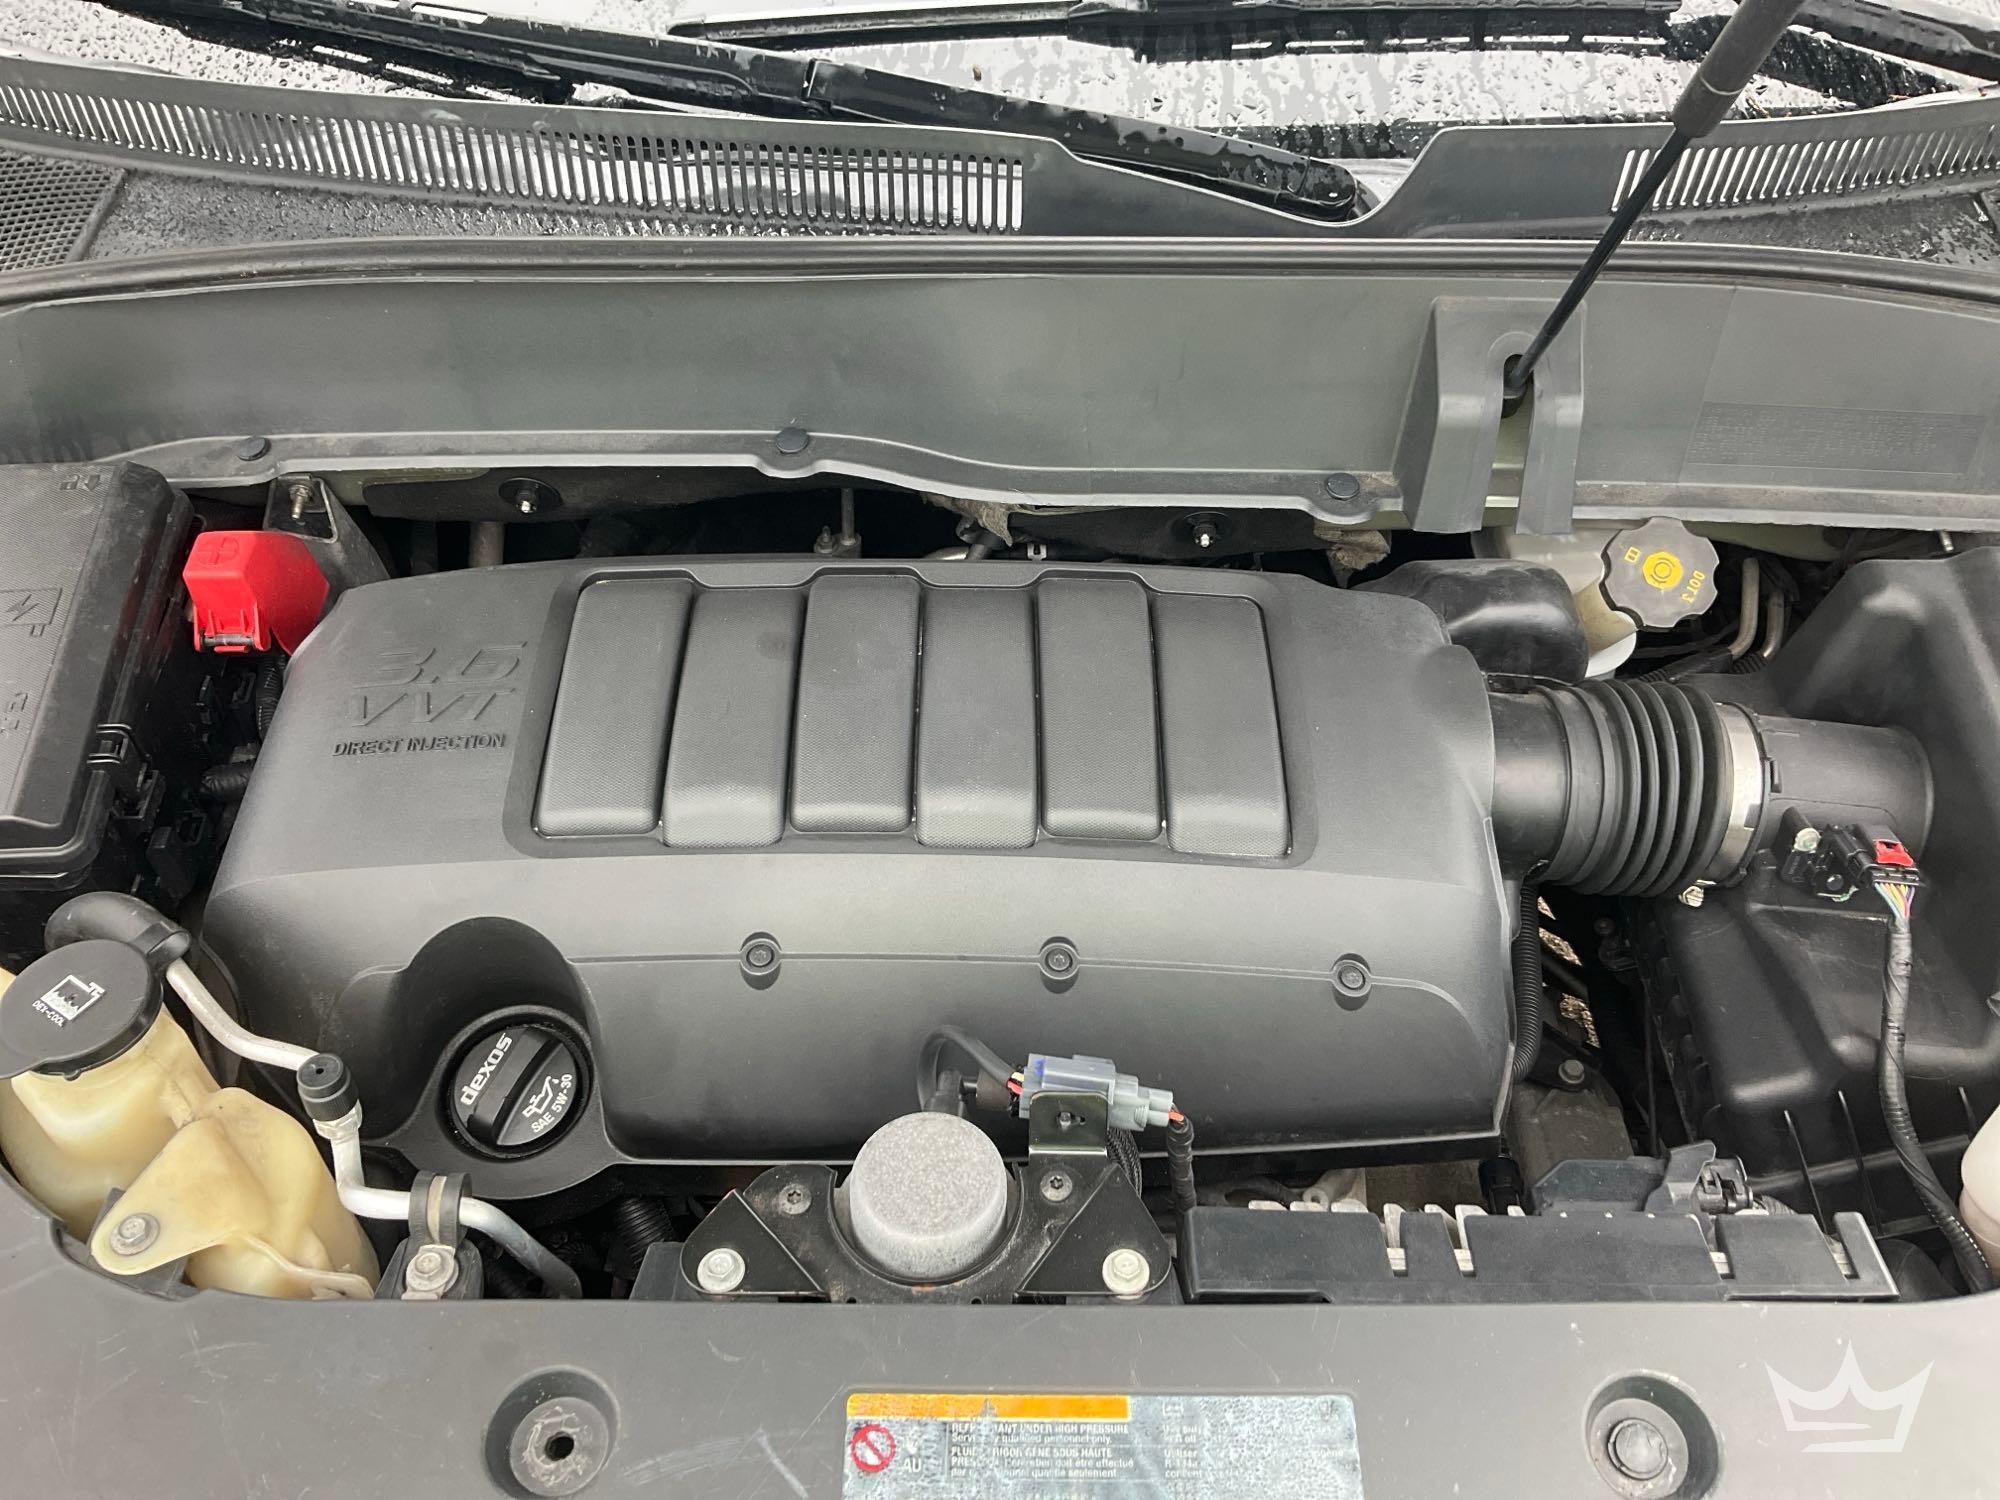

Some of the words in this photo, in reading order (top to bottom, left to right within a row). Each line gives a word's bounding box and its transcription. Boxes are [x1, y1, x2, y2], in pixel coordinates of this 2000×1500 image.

[1686, 570, 1706, 596] DOT
[350, 688, 516, 728] VVT
[332, 738, 405, 757] DIRECT
[406, 733, 508, 754] INJECTION
[32, 1000, 65, 1027] DEX-COOL
[460, 1032, 514, 1106] dexos
[531, 1112, 556, 1133] SAE
[551, 1073, 573, 1113] 5W-30
[1080, 1424, 1129, 1434] PRESSURE
[1053, 1448, 1078, 1457] SOUS
[1081, 1448, 1112, 1457] HAUTE
[1068, 1469, 1117, 1477] seulement
